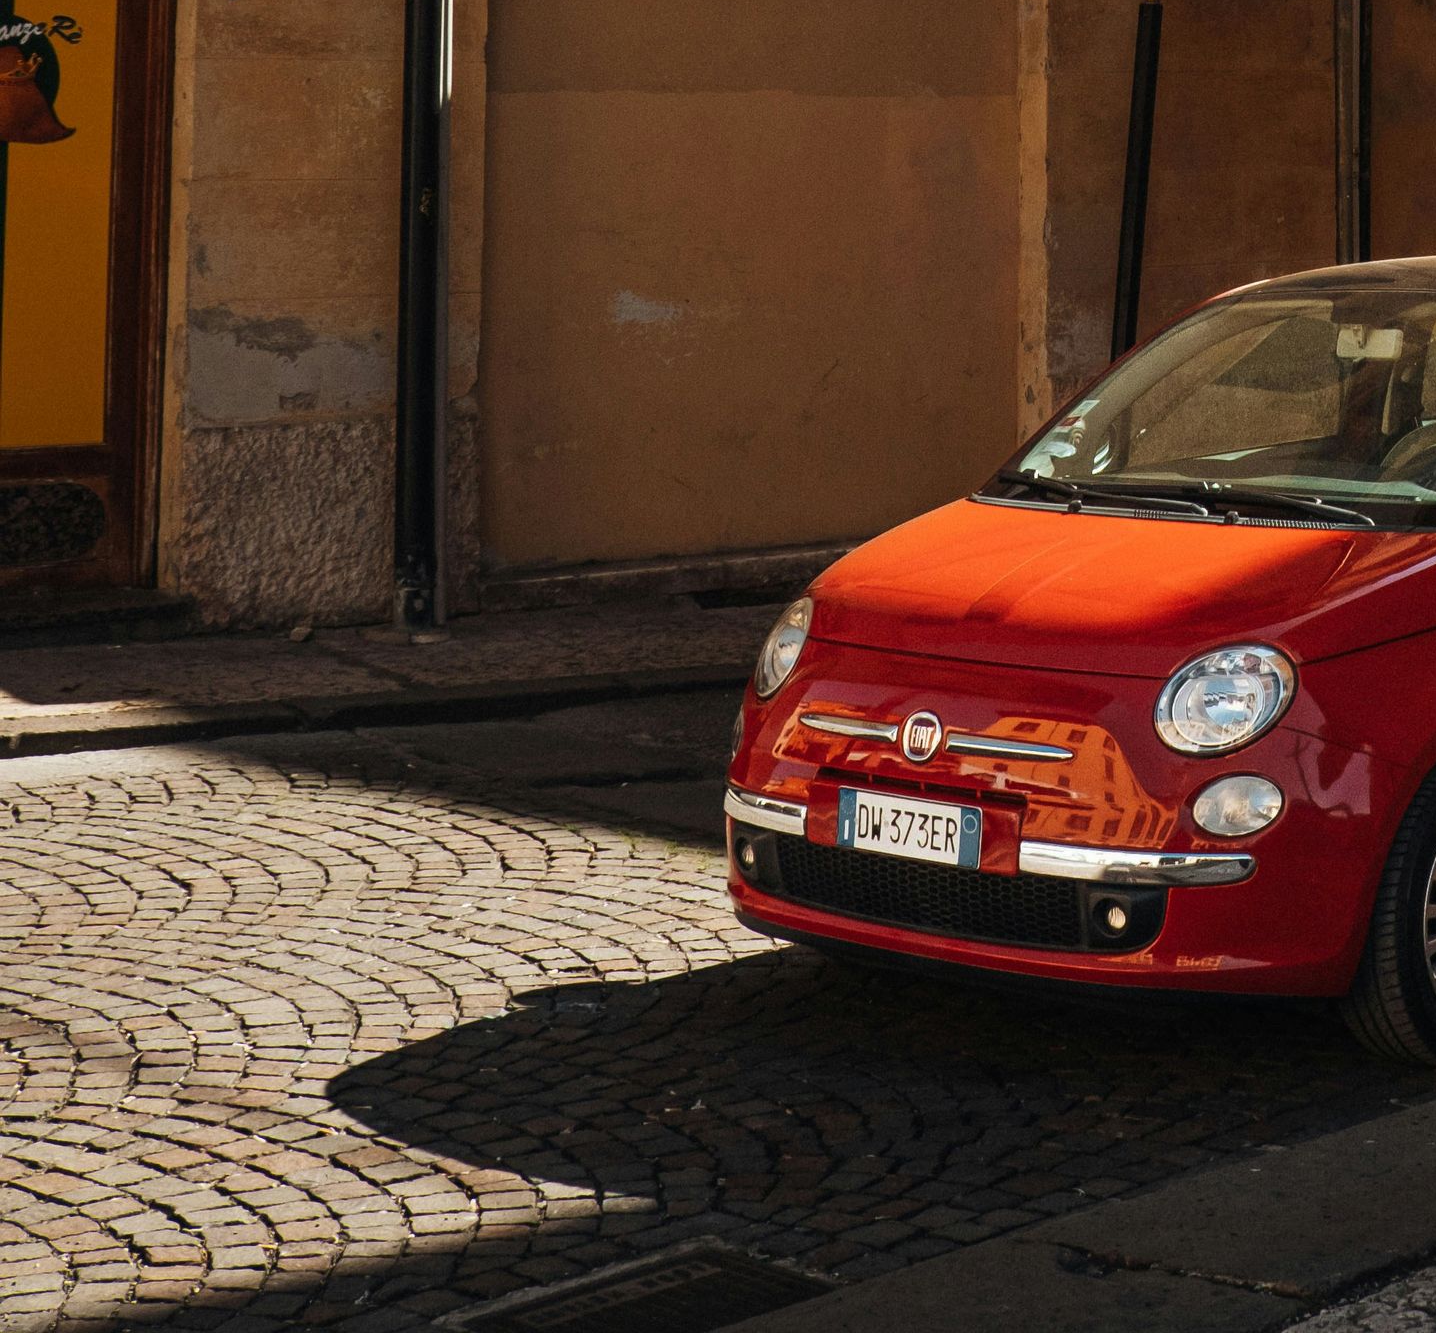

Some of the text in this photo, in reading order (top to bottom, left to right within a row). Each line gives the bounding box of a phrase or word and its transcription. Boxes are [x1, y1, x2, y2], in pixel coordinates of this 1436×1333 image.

[910, 725, 936, 749] FIAT
[857, 803, 883, 842] DW
[889, 808, 958, 854] 373ER
